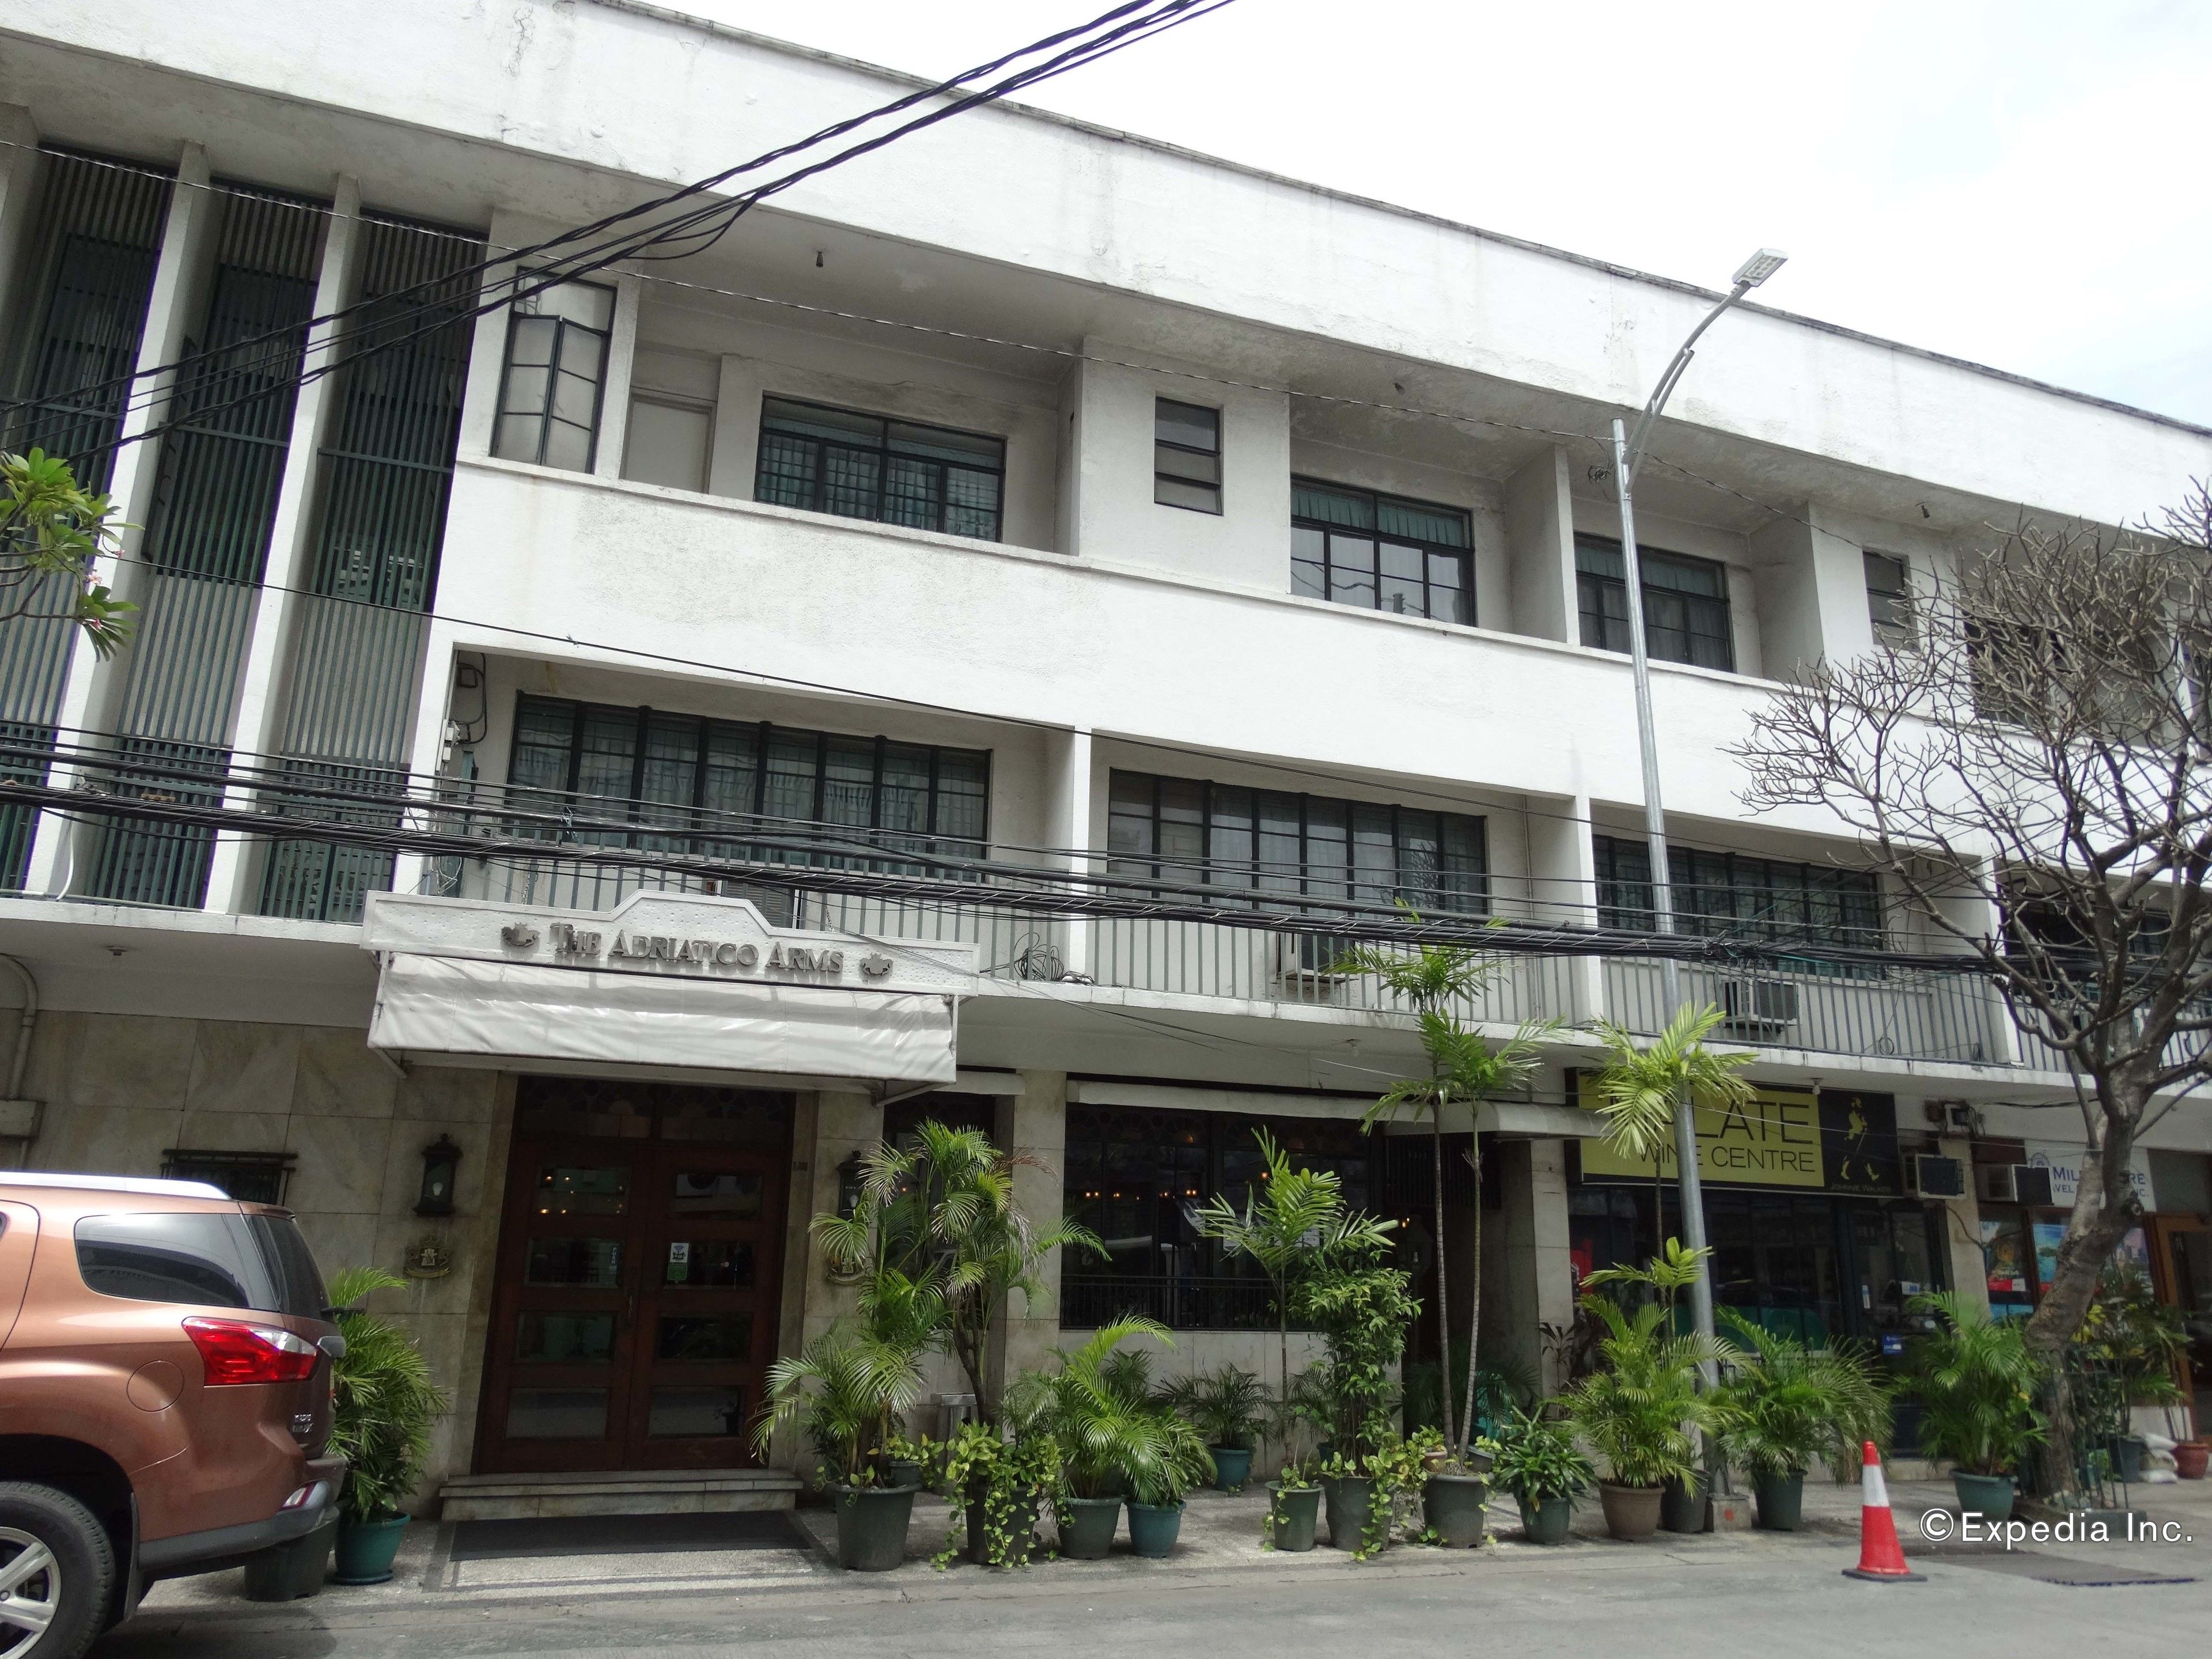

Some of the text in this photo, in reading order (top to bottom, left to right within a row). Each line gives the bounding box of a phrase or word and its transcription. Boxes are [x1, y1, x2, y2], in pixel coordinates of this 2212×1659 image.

[608, 930, 759, 966] ADRIATICO
[766, 941, 843, 972] ARMS
[1711, 1146, 1816, 1173] CENTRE
